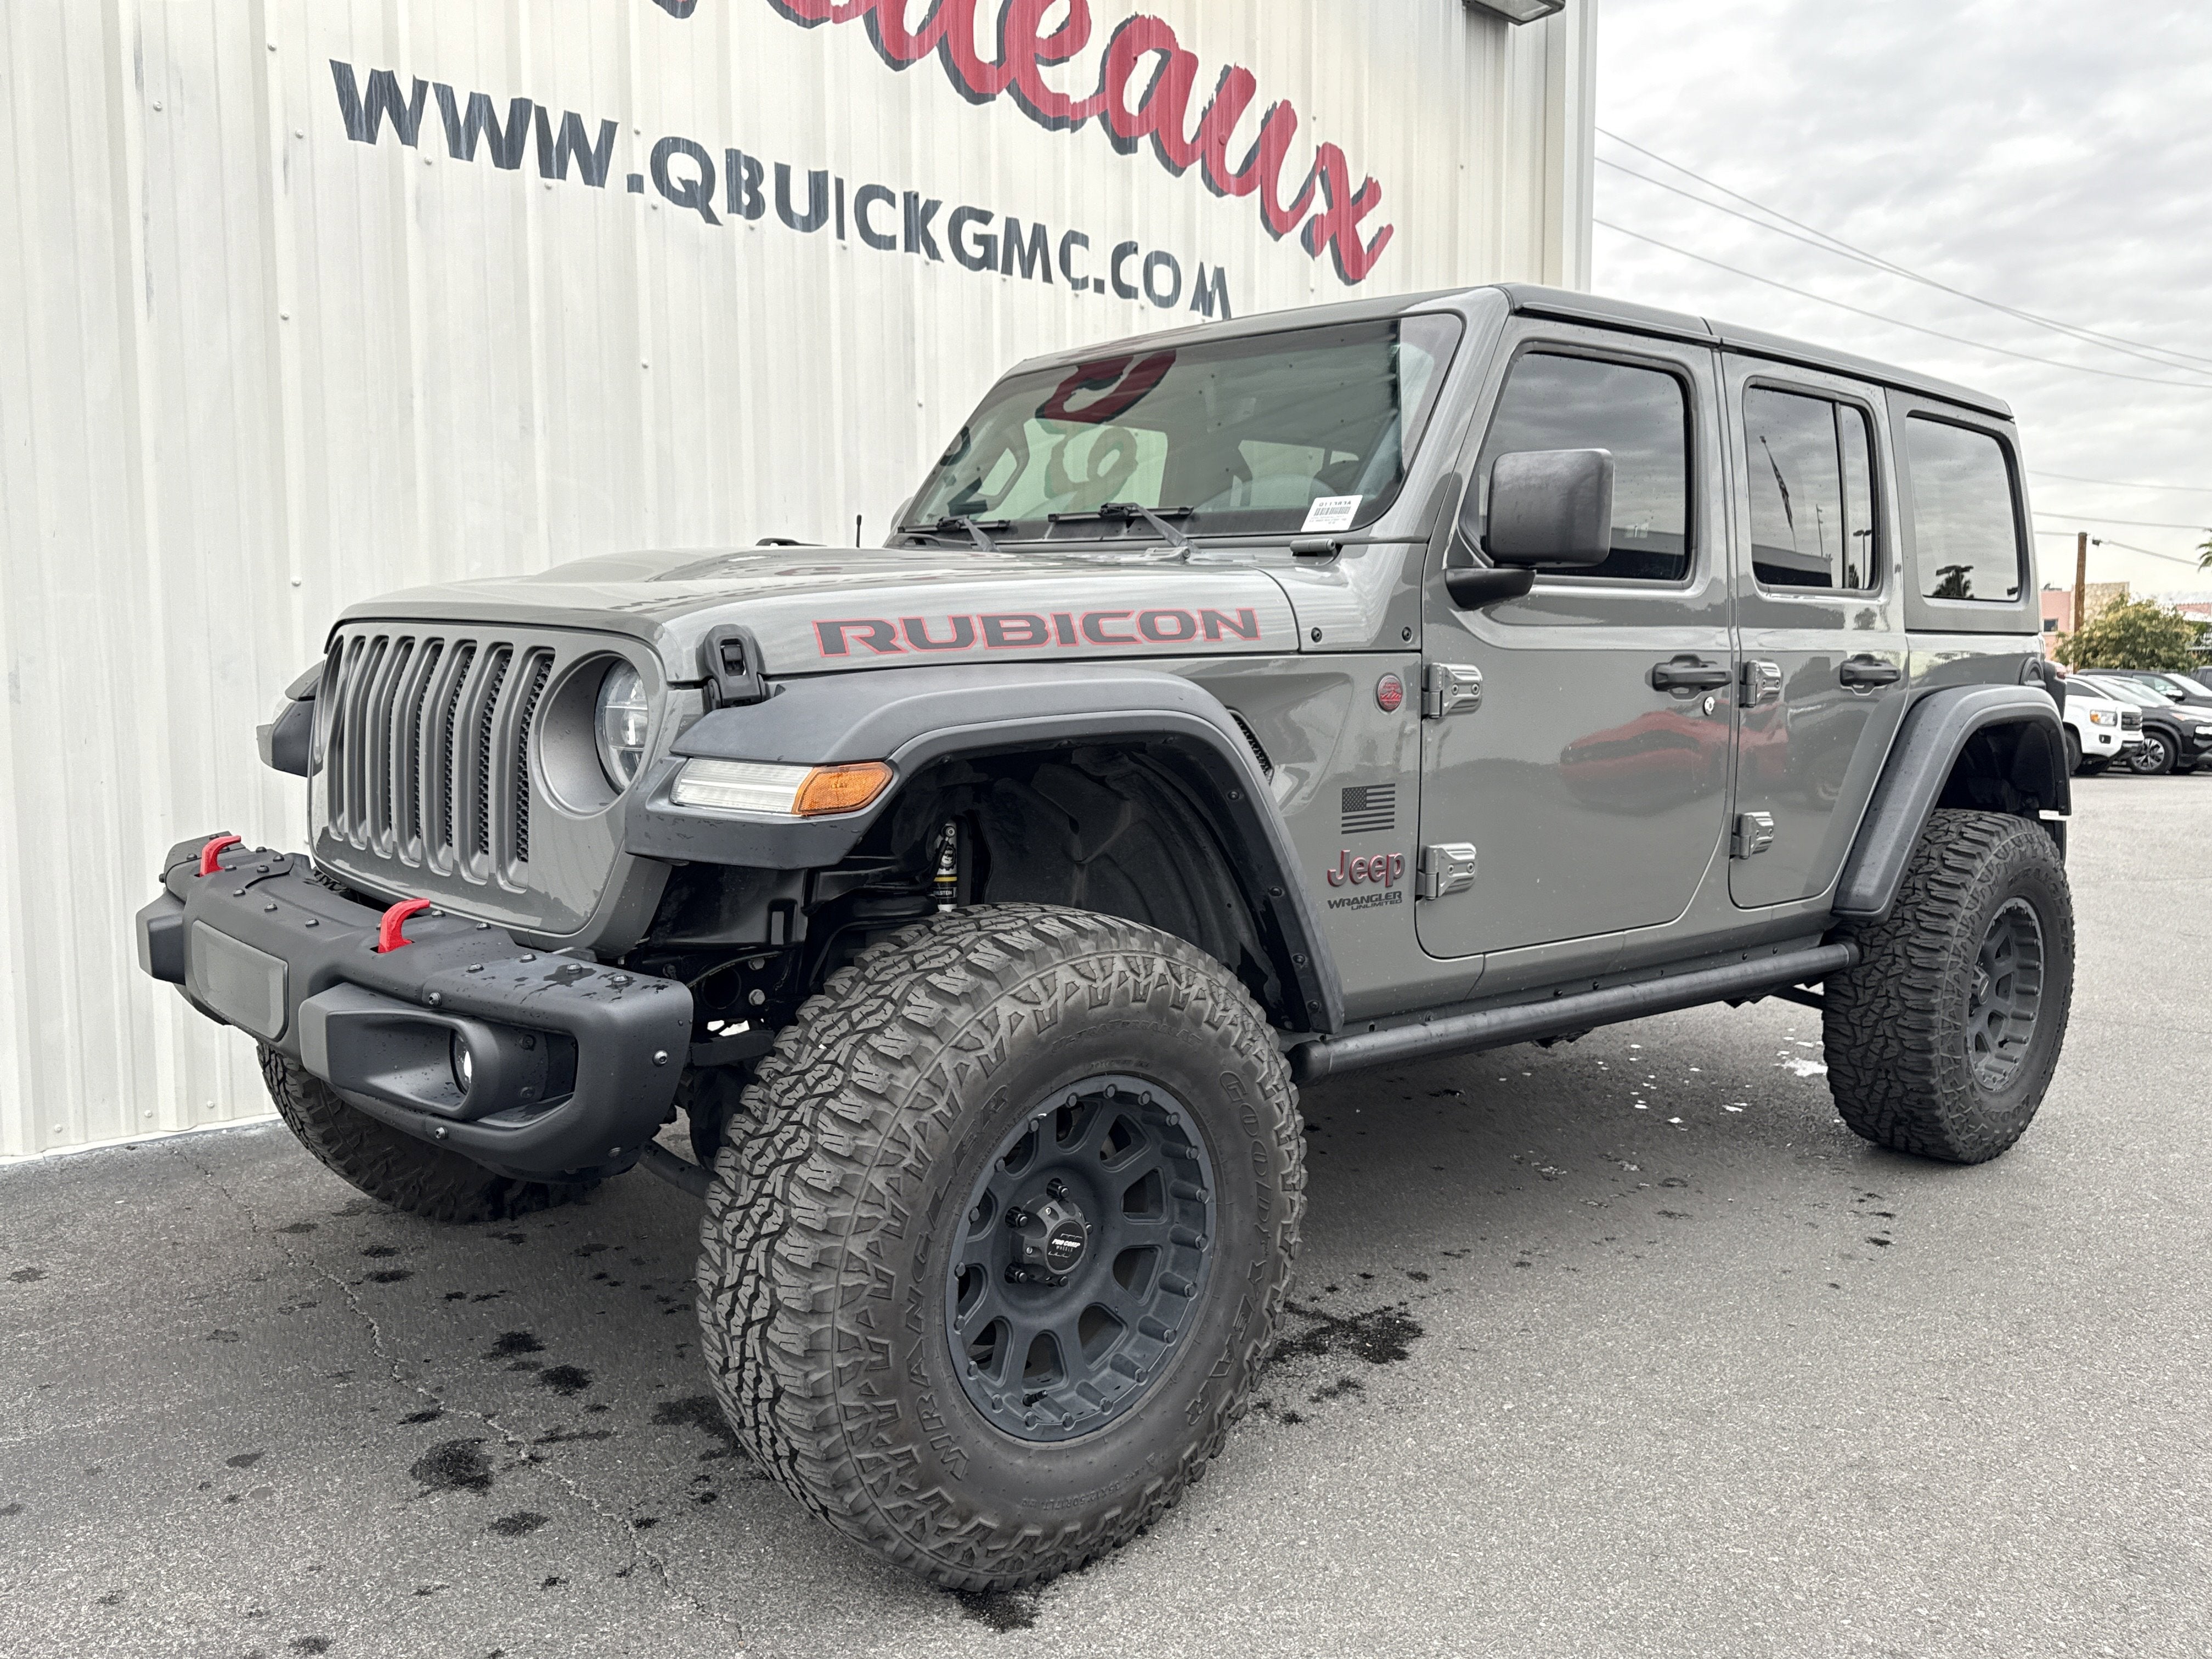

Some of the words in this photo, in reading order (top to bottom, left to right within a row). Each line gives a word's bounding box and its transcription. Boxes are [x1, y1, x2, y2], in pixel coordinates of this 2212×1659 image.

[329, 58, 1232, 320] WWW.QBUICKGMC.COM
[812, 608, 1261, 657] RUBICON
[1327, 849, 1406, 888] Jeep
[1327, 890, 1402, 910] WRANGLER
[1351, 899, 1402, 911] UNLIMITED
[1185, 1071, 1273, 1425] GOODYEAR
[905, 1085, 1008, 1481] WRANGLER
